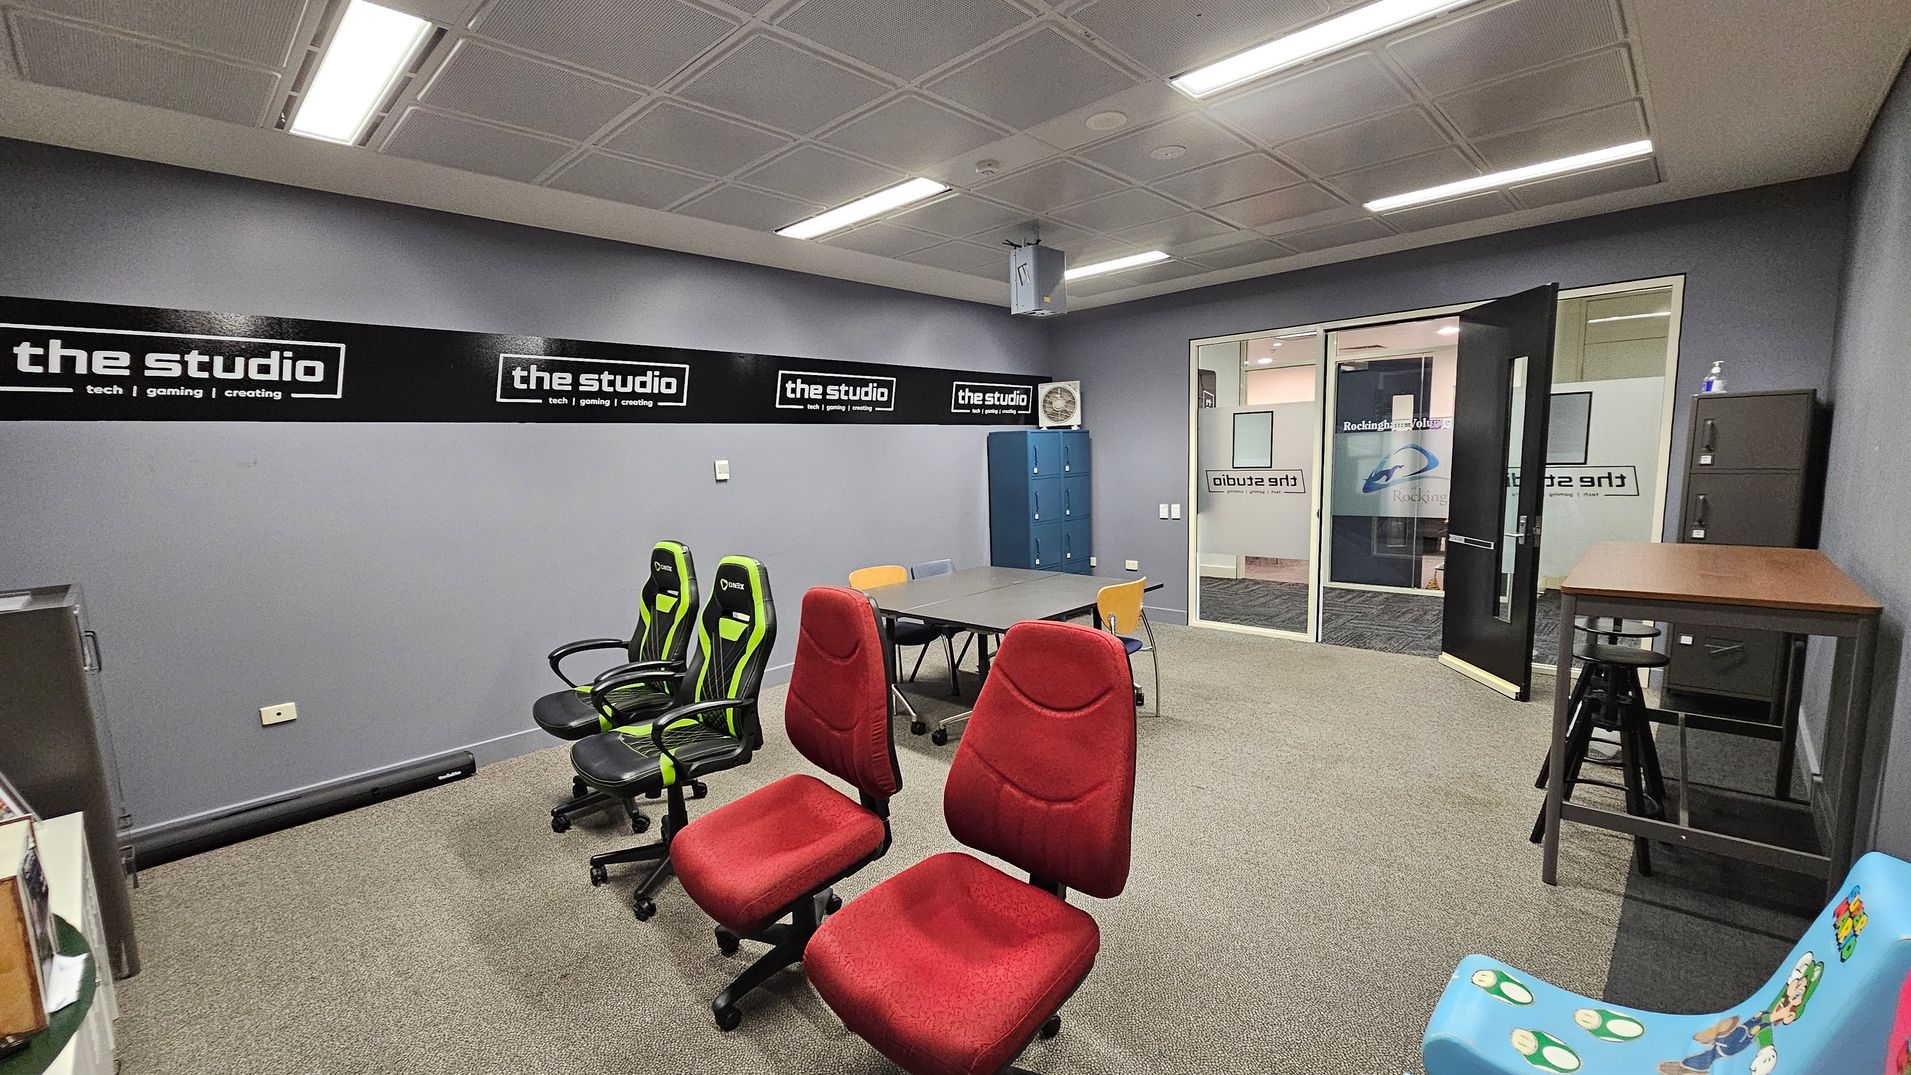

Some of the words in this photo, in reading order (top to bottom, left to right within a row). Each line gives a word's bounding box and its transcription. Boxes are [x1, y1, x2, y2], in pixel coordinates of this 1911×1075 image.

[13, 339, 131, 376] the
[144, 350, 325, 382] studio
[512, 364, 573, 391] the
[578, 371, 678, 394] studio
[86, 384, 123, 395] tech
[146, 386, 204, 398] gaming
[224, 388, 283, 400] creating
[785, 378, 823, 400] the
[826, 383, 889, 402] studio
[958, 387, 984, 405] the
[984, 389, 1028, 406] studio
[548, 396, 569, 405] tech
[579, 397, 611, 407] gaming
[621, 398, 653, 408] creating
[1393, 487, 1448, 506] Rocking
